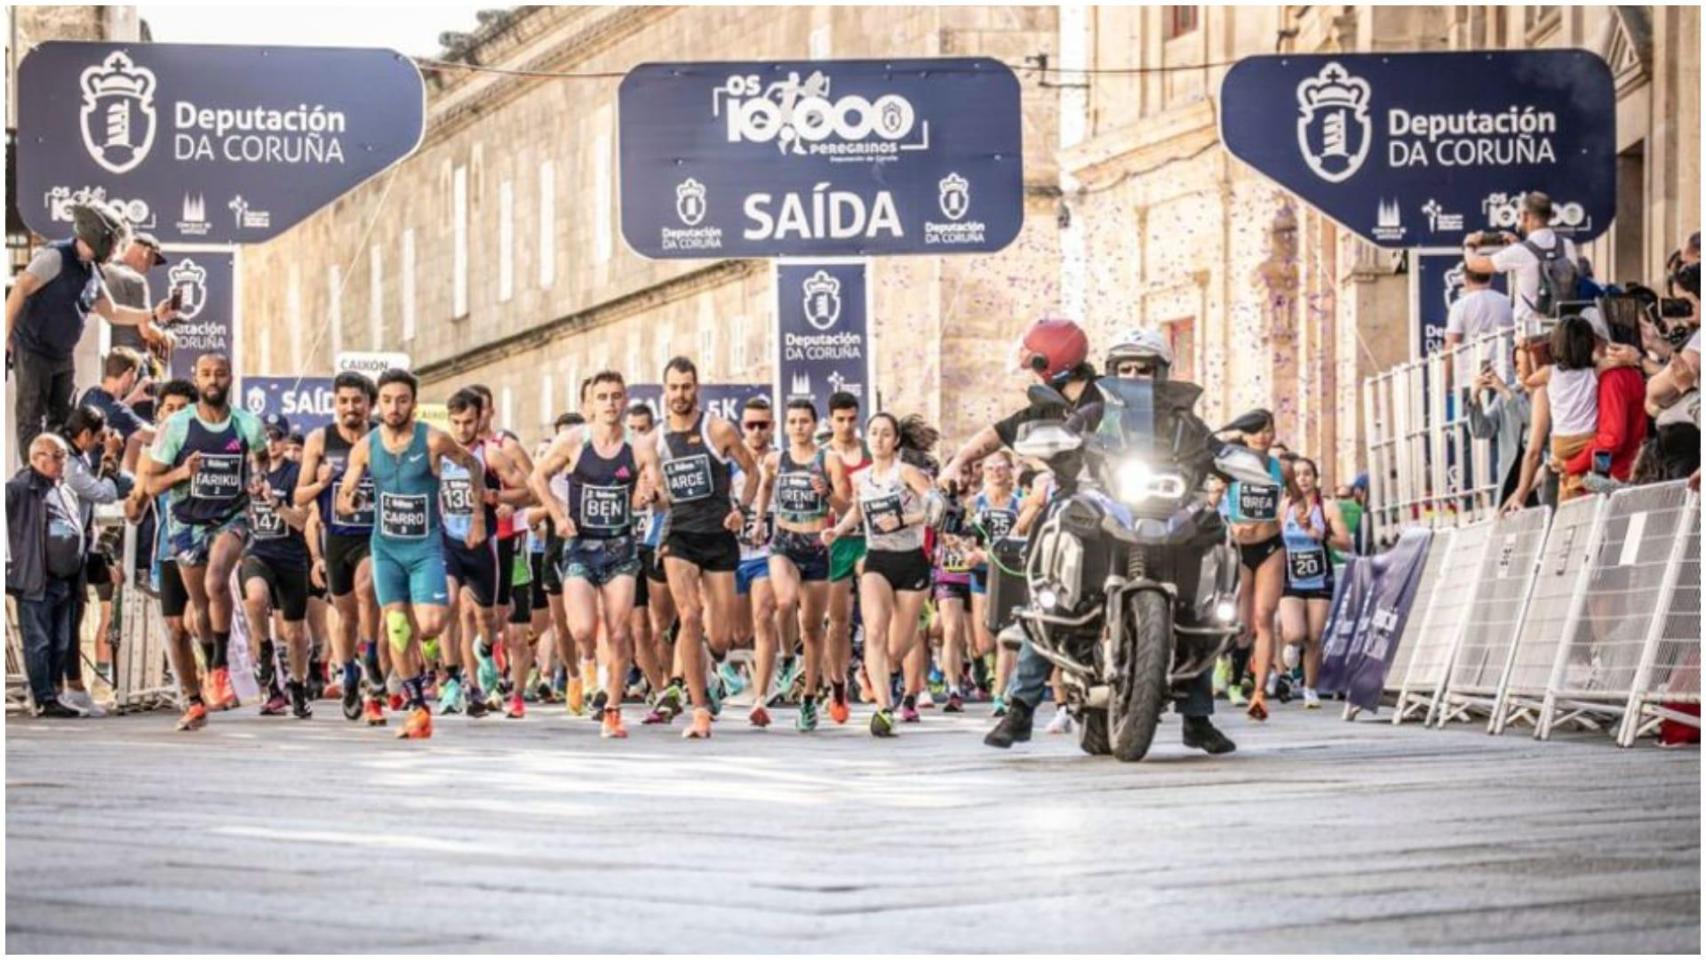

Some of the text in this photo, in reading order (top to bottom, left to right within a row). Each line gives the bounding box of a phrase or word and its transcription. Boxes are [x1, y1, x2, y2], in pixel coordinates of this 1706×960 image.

[726, 75, 761, 96] OS
[175, 102, 345, 137] Deputación
[1389, 105, 1556, 142] Deputación
[175, 133, 344, 163] DA CORUÑA
[1389, 134, 1556, 167] DA CORUÑA
[743, 182, 904, 240] SAÍDA
[662, 227, 722, 240] Deputación
[925, 221, 985, 235] Deputación
[662, 236, 722, 249] DA CORUÑA
[925, 231, 985, 244] DA CORUÑA
[786, 331, 862, 349] Deputación
[786, 344, 862, 360] DA CORUÑA
[282, 386, 336, 415] SAÍD
[196, 472, 238, 487] FARIKU
[671, 471, 705, 490] ARCE
[587, 500, 622, 517] BEN
[251, 513, 280, 530] 147
[384, 510, 425, 526] CARRO
[1296, 560, 1319, 577] 20
